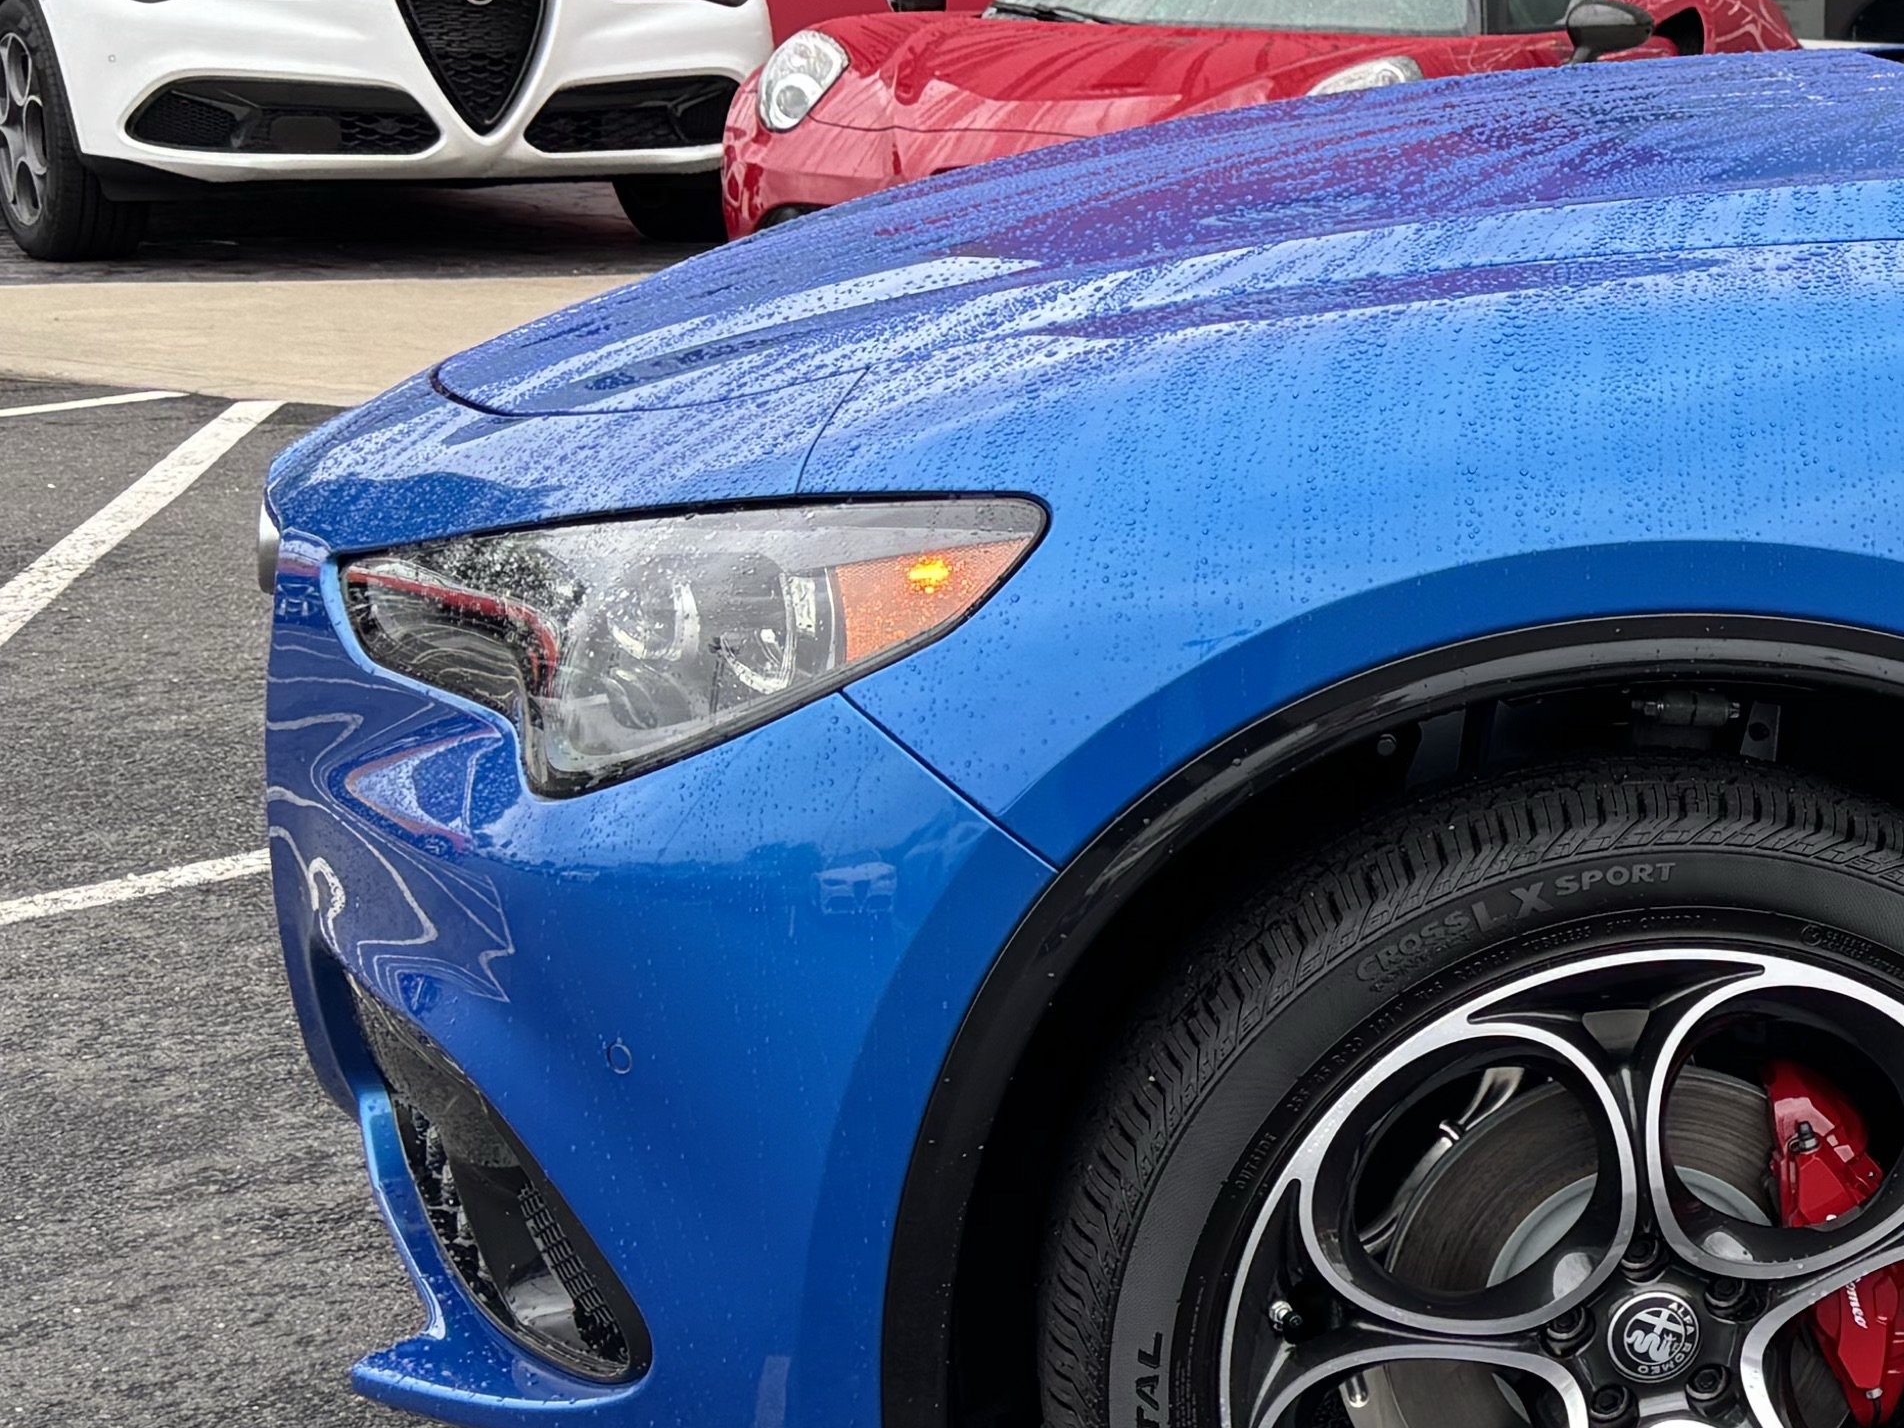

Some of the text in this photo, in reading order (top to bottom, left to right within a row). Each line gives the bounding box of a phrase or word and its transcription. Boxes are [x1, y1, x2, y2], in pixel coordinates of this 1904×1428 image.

[1356, 910, 1464, 982] CROSS
[1555, 862, 1676, 895] SPORT
[1637, 1302, 1695, 1375] ALFA ROMEO
[1846, 1277, 1868, 1329] omeo
